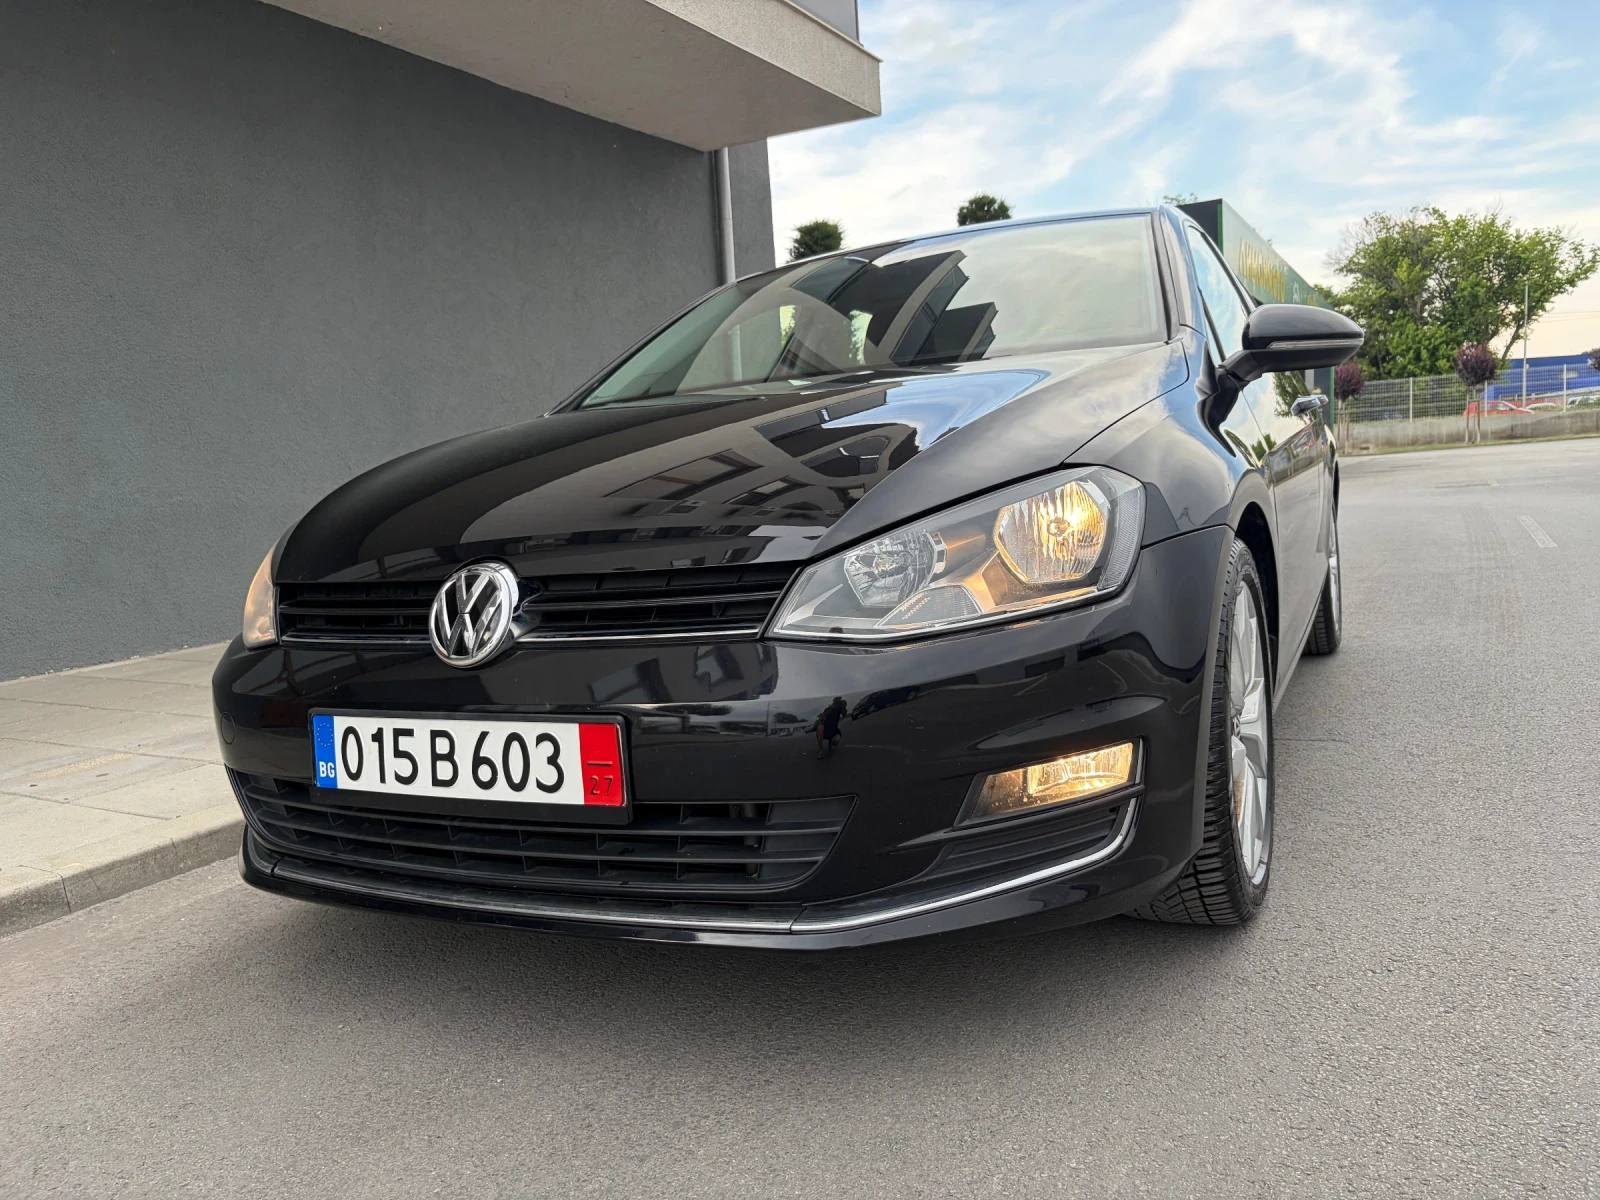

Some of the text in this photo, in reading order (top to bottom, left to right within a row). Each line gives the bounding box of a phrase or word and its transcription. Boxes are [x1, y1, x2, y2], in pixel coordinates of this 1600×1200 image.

[435, 571, 503, 660] VW
[319, 760, 336, 779] BG
[589, 774, 614, 796] 27
